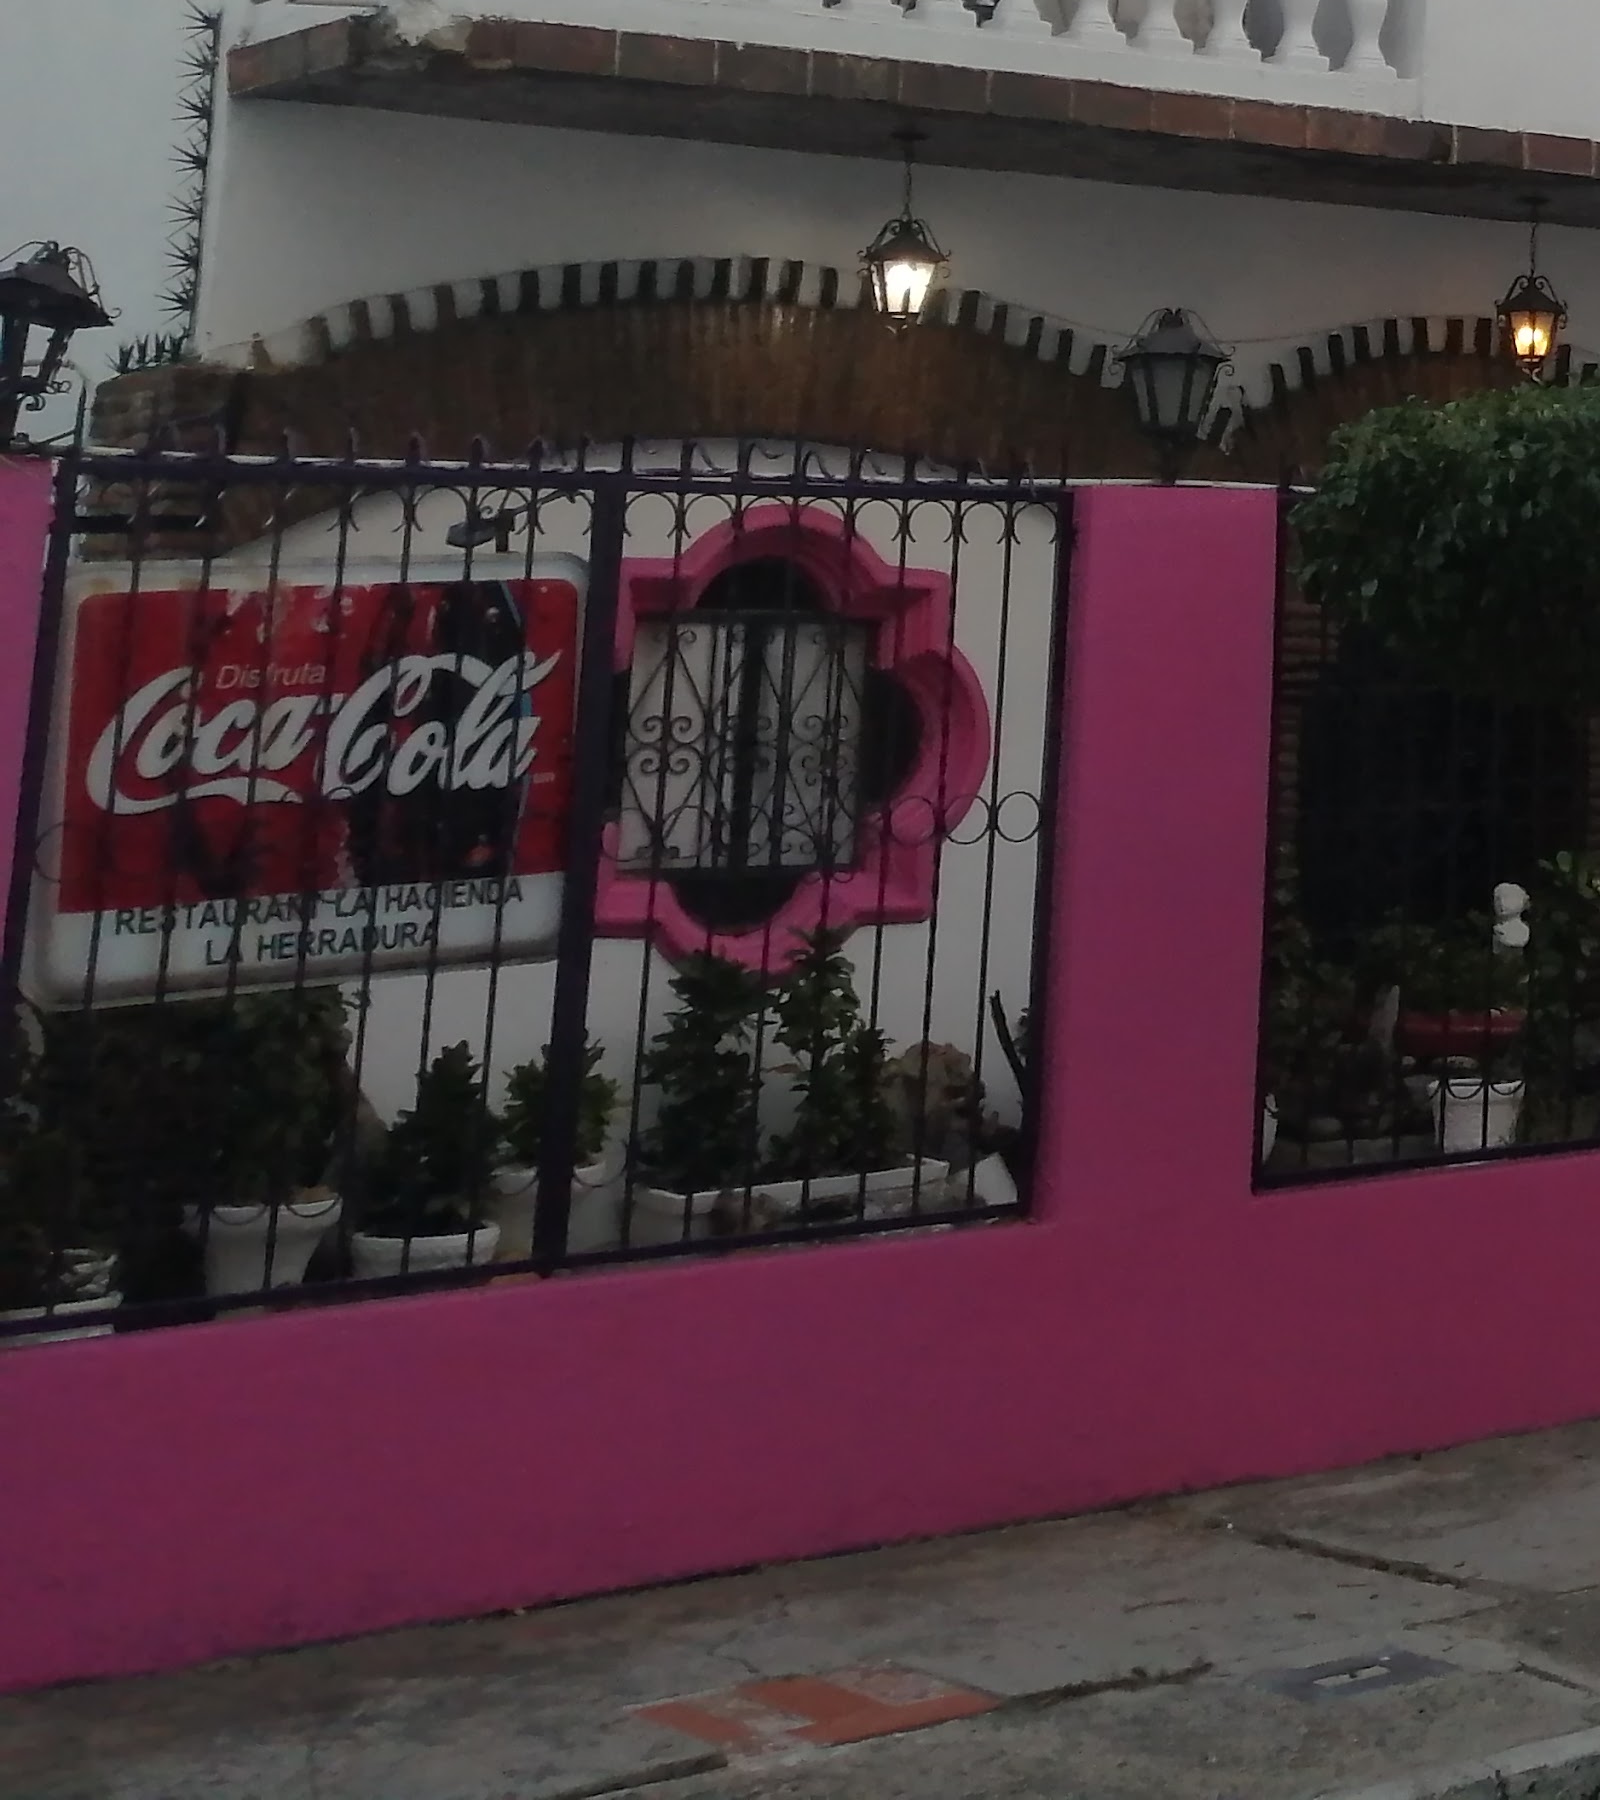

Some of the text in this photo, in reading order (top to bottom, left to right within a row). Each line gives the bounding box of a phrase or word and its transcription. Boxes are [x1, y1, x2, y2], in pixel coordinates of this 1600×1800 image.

[85, 647, 564, 814] Coca-Cola
[383, 877, 523, 912] HACIENDA
[205, 921, 437, 966] LA HERRADURA
